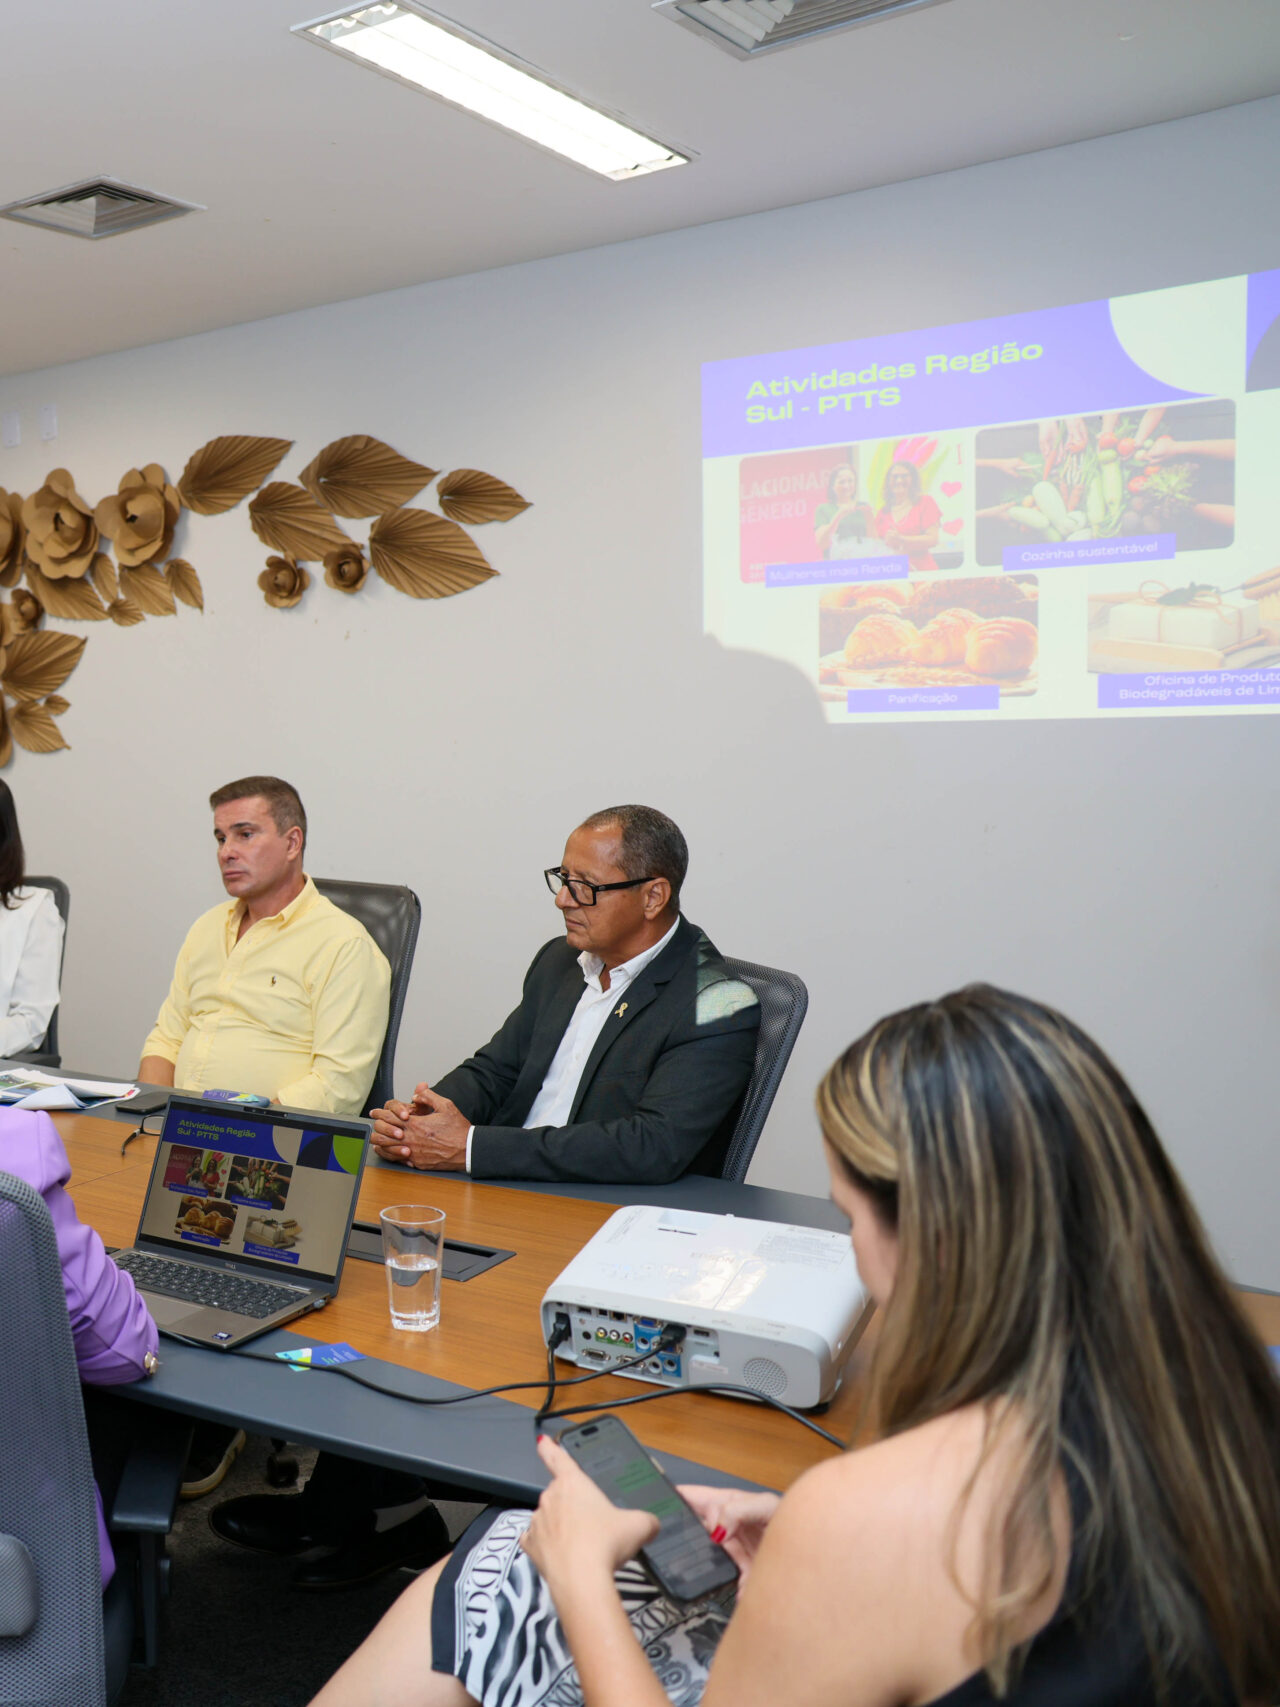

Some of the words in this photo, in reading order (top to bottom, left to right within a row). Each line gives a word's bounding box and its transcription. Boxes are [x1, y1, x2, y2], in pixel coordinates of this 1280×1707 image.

[745, 363, 916, 400] Atividades
[925, 341, 1044, 374] Região
[745, 400, 793, 424] Sul
[818, 387, 901, 415] PTTS
[1022, 549, 1075, 562] Cozinha
[1077, 541, 1158, 558] sustentável
[1144, 675, 1195, 686] Oficina
[1198, 674, 1217, 684] de
[888, 693, 958, 705] Panificação
[1119, 685, 1232, 701] Biodegradáveis
[1235, 685, 1254, 696] de
